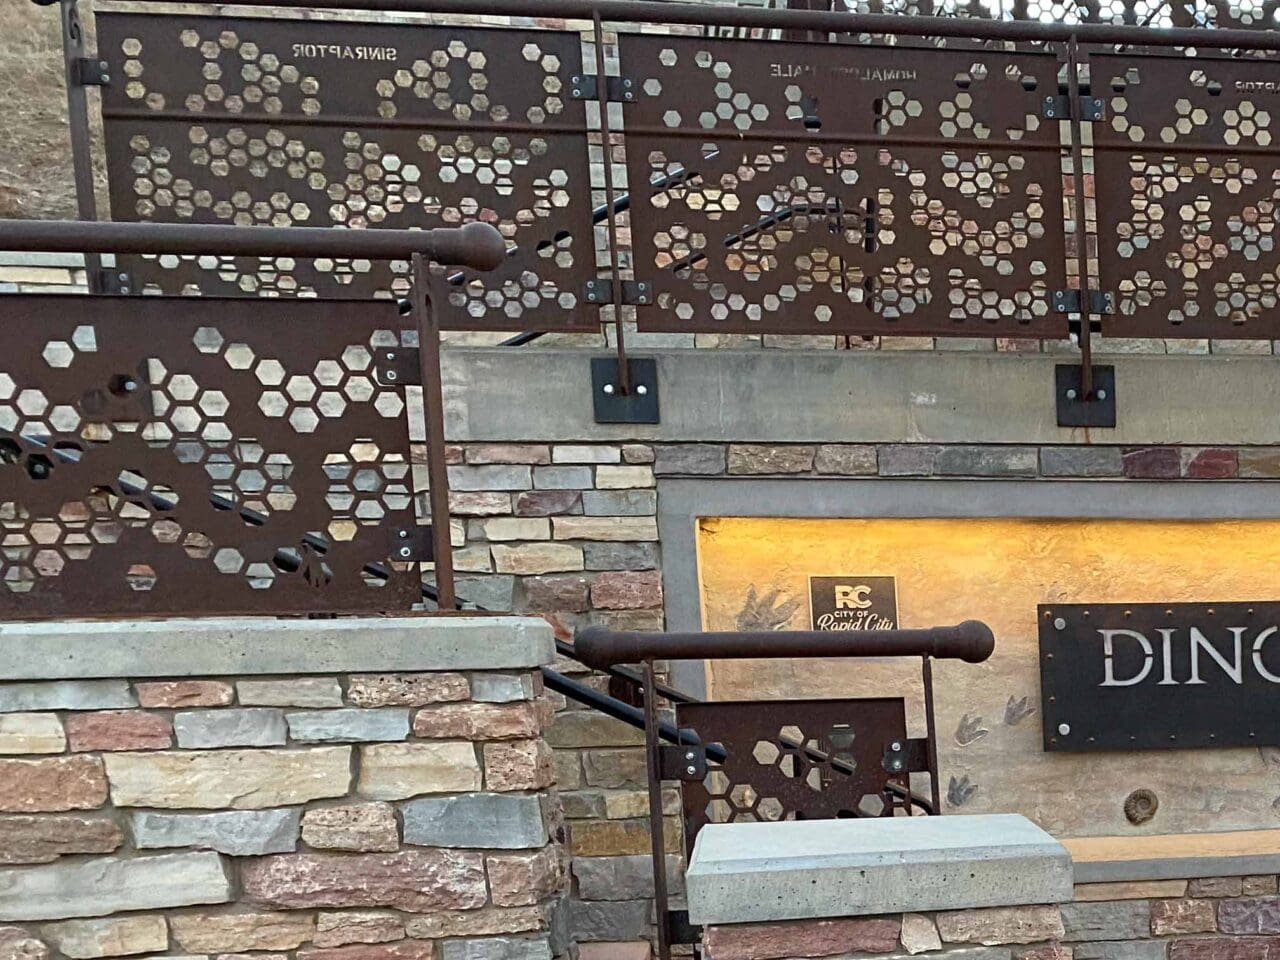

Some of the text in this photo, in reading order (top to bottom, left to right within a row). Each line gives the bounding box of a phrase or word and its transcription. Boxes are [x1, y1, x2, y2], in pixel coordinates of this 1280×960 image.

[834, 585, 872, 609] RC
[817, 613, 894, 631] Rapid City
[834, 610, 869, 618] CITY OF
